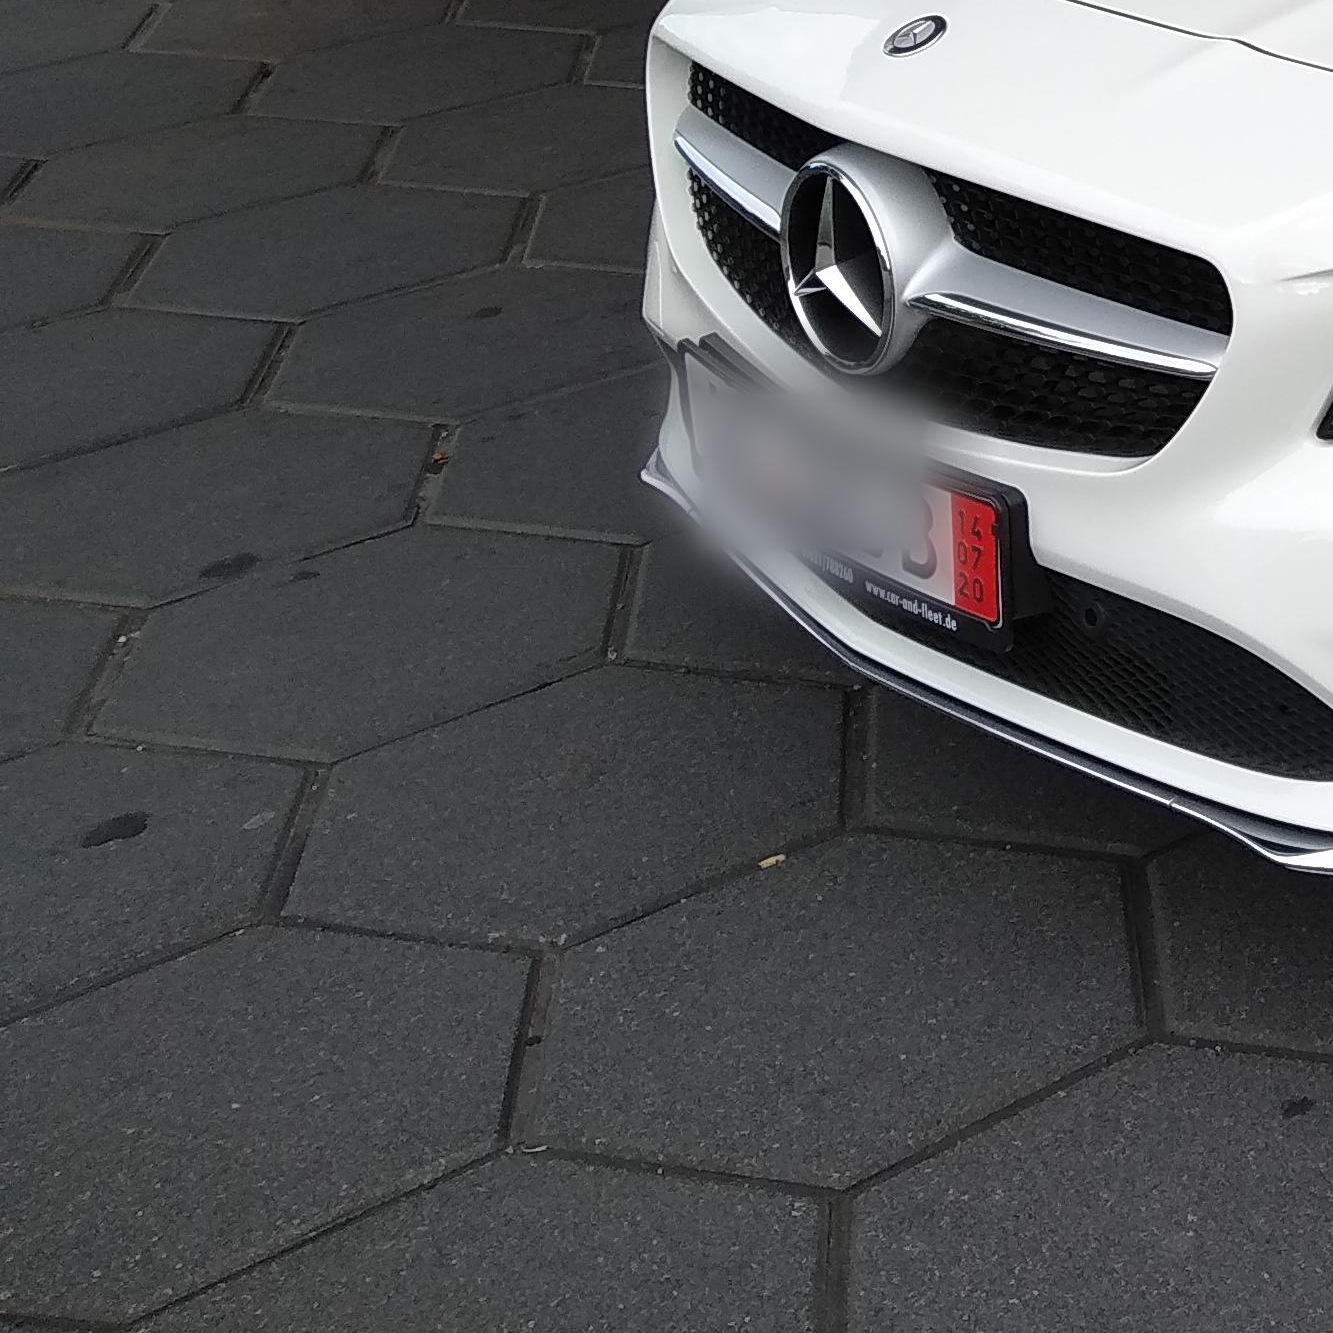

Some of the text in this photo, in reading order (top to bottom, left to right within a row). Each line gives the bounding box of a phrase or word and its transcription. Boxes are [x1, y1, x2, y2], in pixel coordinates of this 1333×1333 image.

[958, 509, 982, 542] 14
[957, 541, 983, 570] 07
[957, 573, 984, 603] 20
[865, 580, 958, 632] www.car-and-fleet.de
